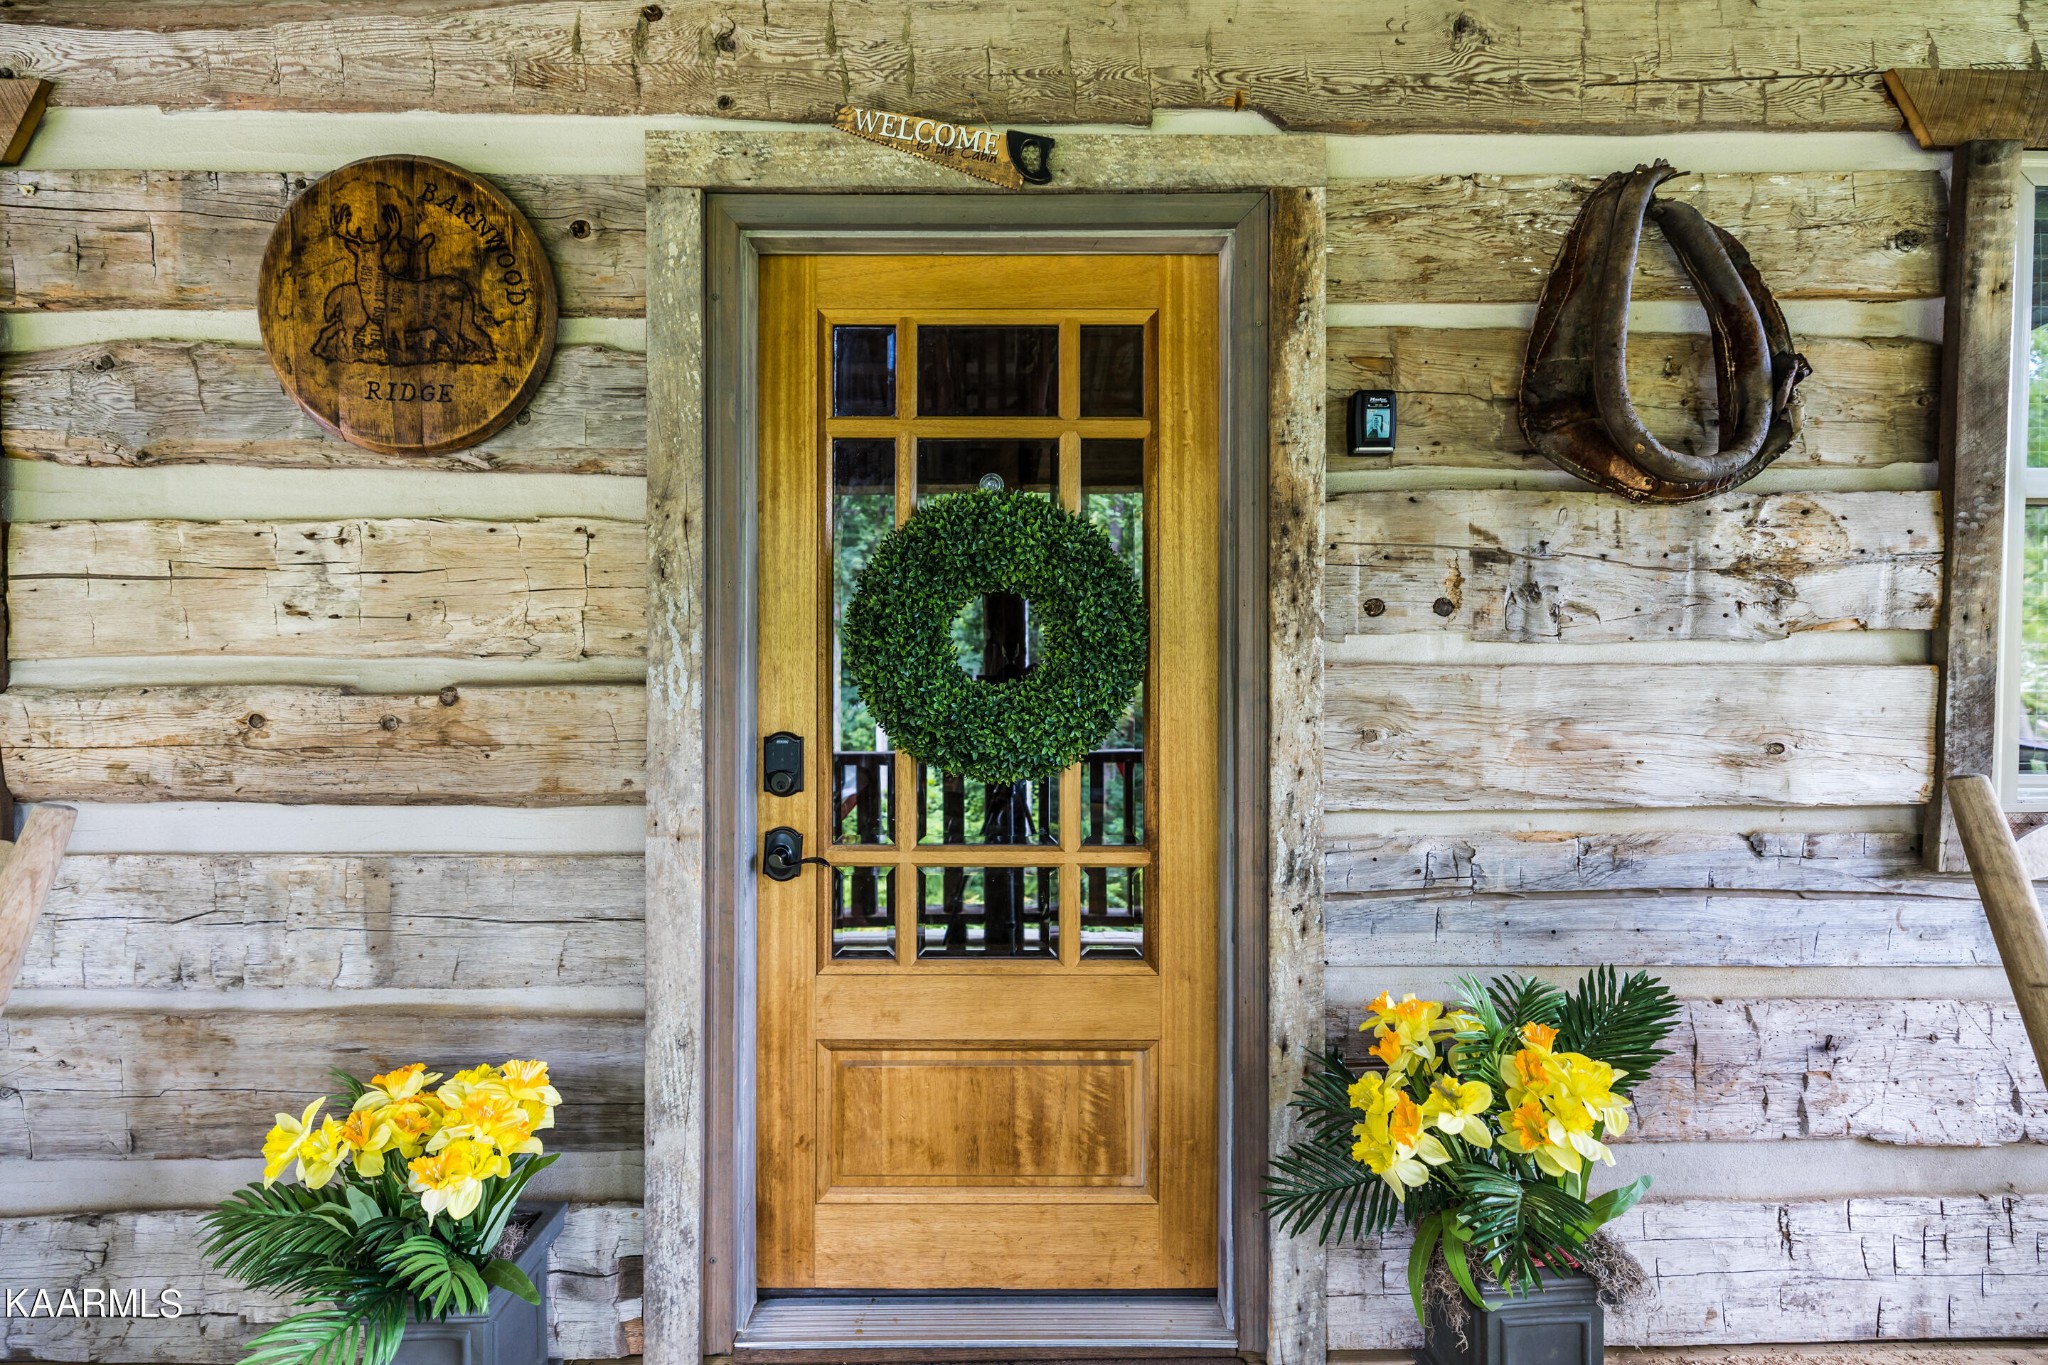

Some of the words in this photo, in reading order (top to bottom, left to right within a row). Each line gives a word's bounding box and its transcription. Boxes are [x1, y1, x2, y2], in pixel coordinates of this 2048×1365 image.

[854, 108, 1000, 156] WELCOME
[916, 140, 930, 152] to
[935, 141, 955, 157] the
[960, 146, 998, 164] Cabin
[417, 181, 527, 307] BARNWOOD
[364, 380, 455, 403] RIDGE
